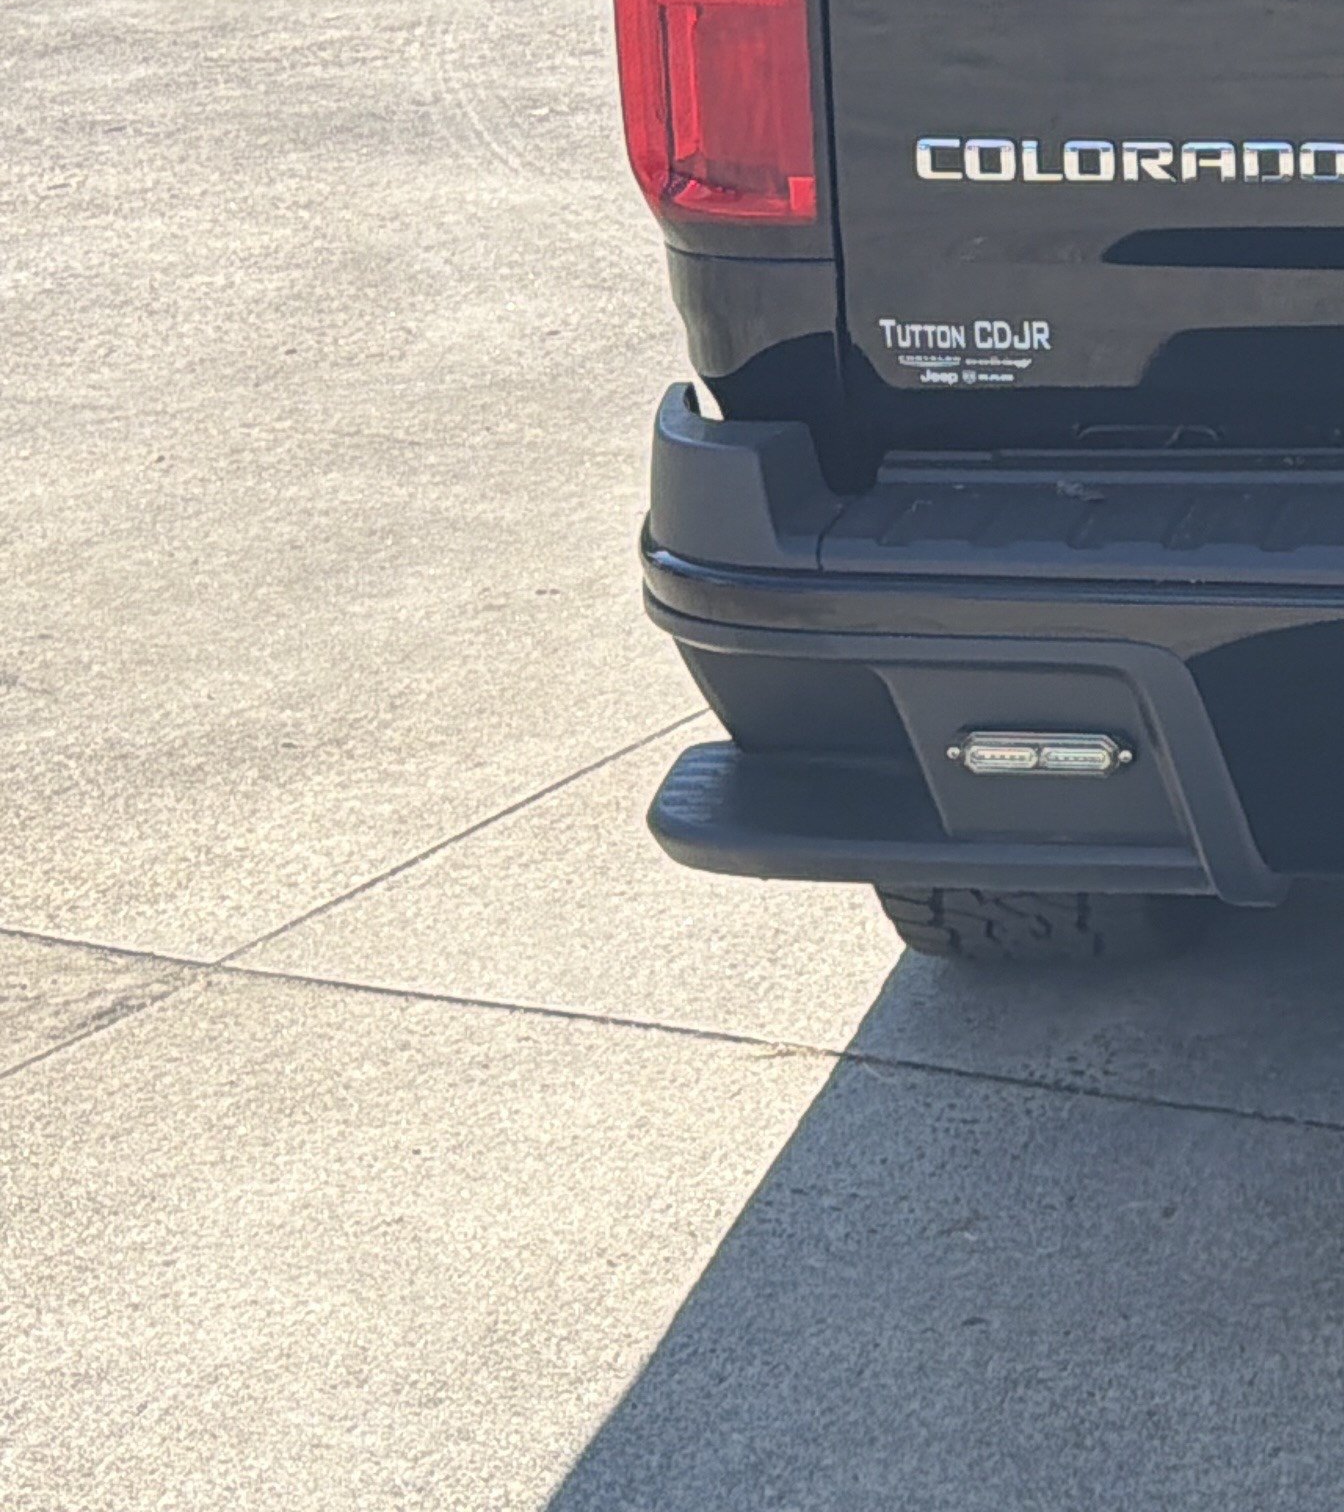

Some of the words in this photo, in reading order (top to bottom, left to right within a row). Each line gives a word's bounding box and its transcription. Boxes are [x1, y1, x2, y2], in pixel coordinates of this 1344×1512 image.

[878, 318, 967, 350] TUTTON
[973, 320, 1052, 351] CDJR
[920, 369, 959, 386] Jeep
